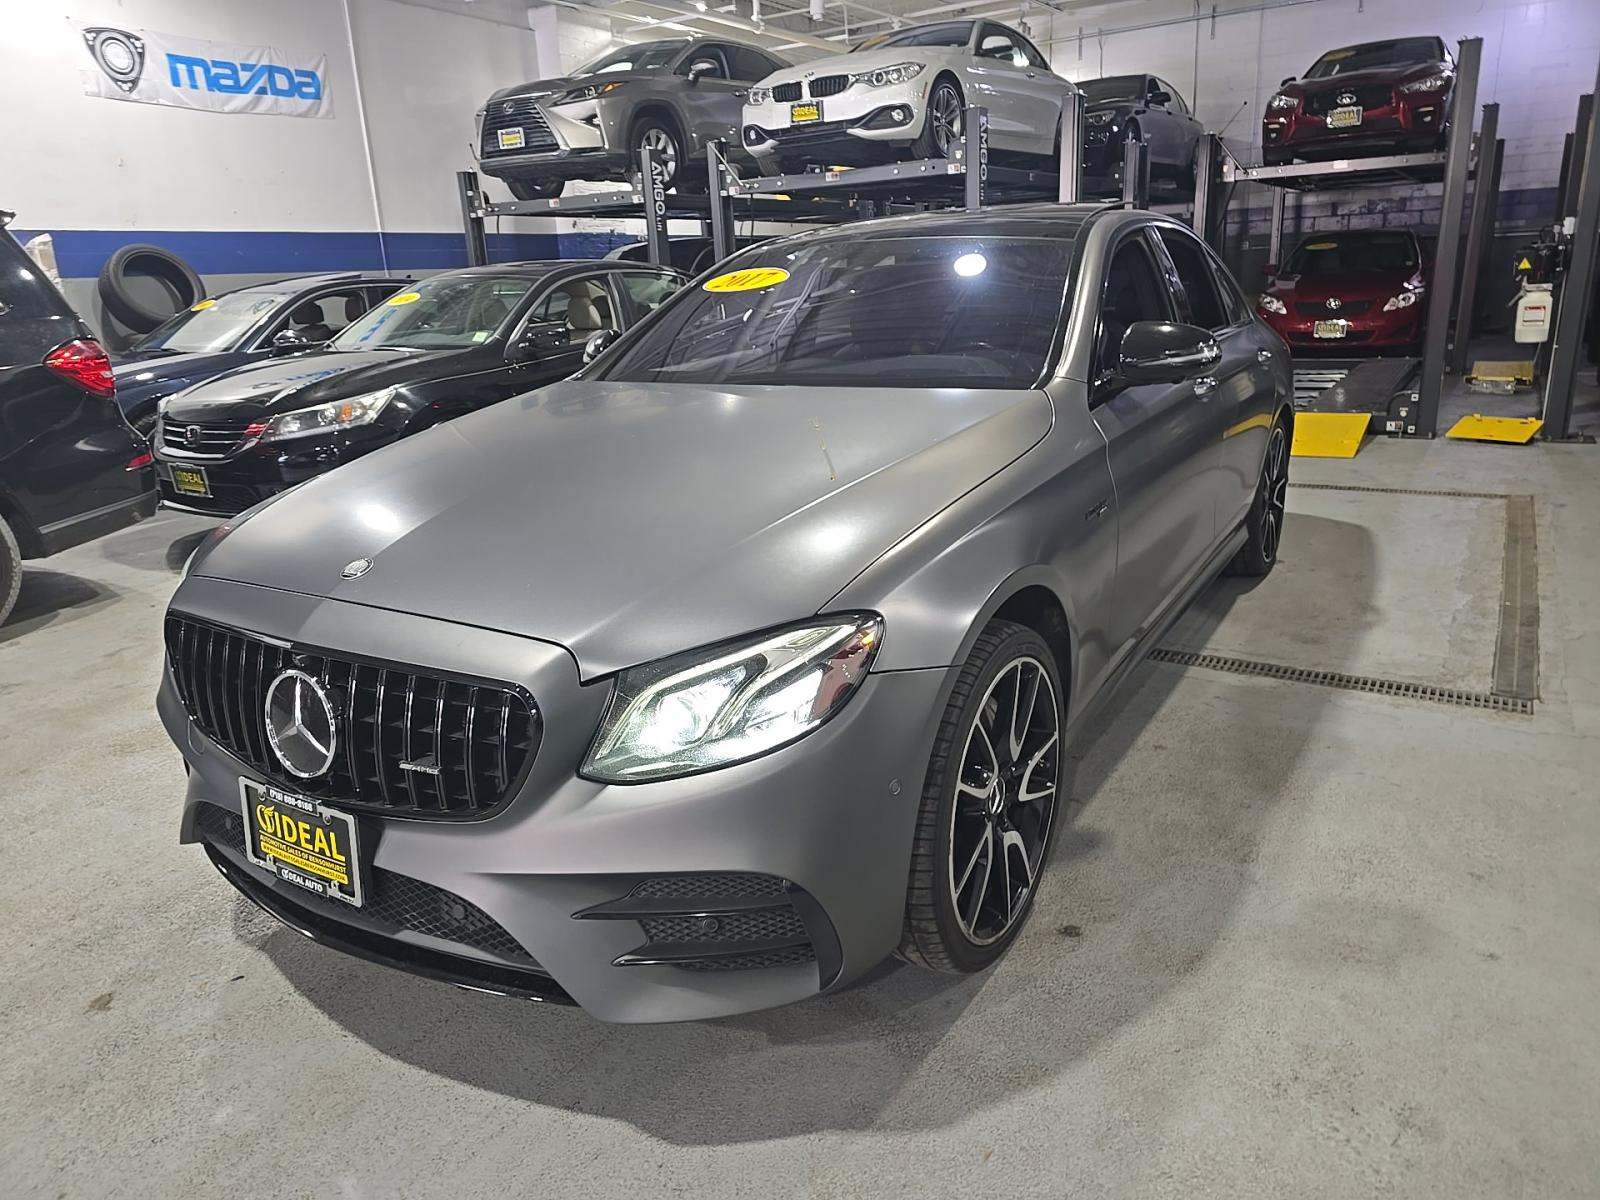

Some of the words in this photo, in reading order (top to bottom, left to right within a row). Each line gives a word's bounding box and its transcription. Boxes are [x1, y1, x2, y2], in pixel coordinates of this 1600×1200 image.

[651, 161, 666, 215] AMGO
[274, 812, 346, 861] IDEAL
[305, 878, 323, 893] AUTO
